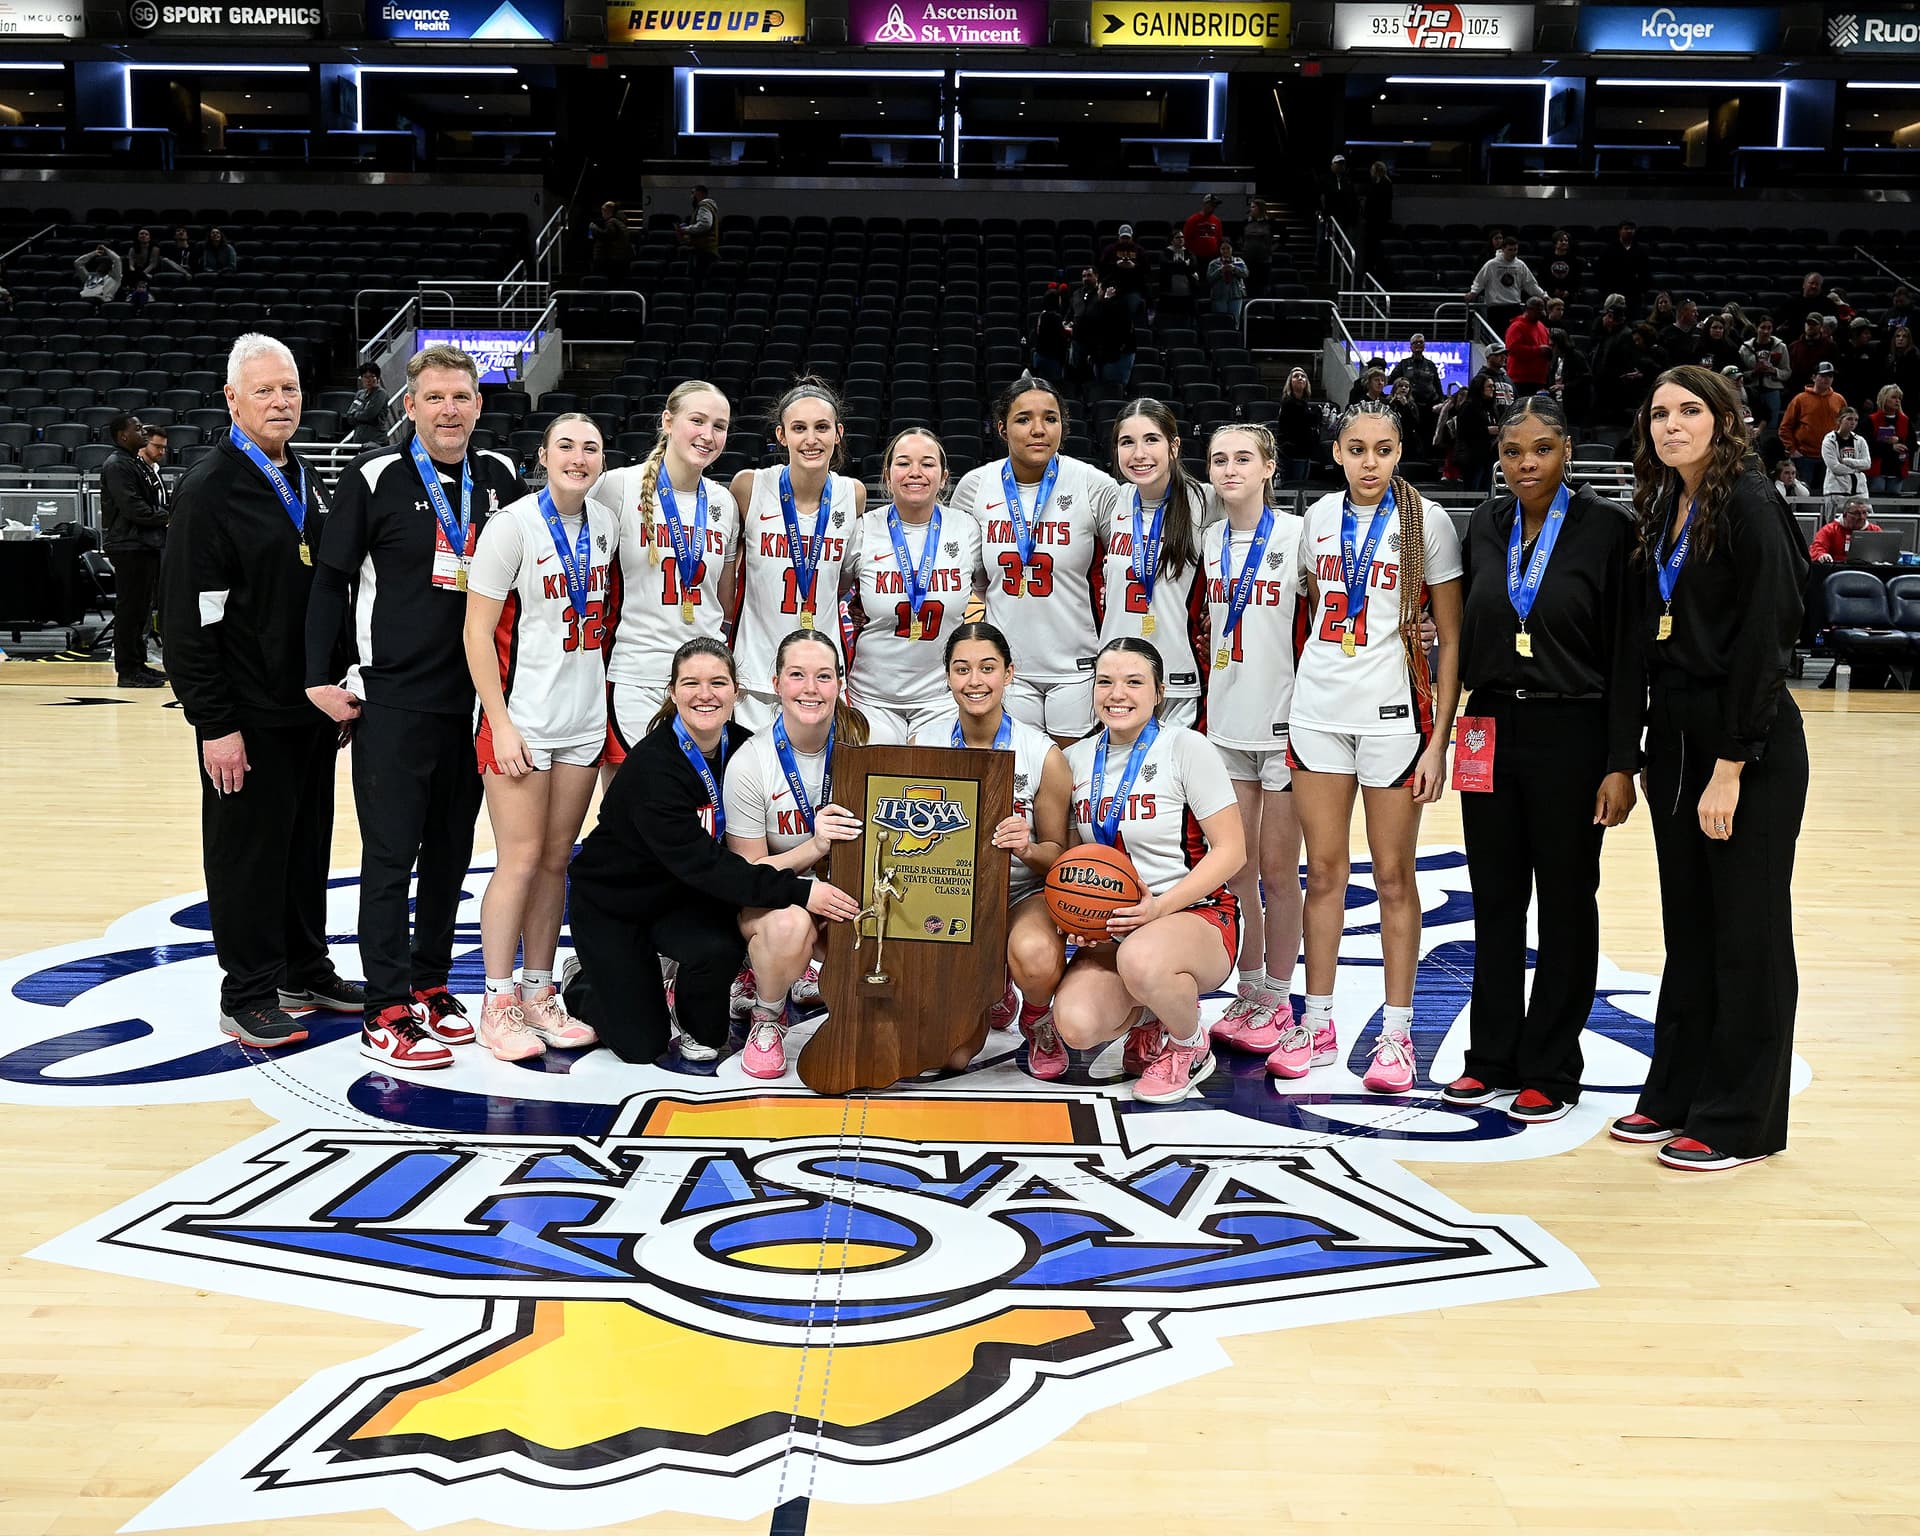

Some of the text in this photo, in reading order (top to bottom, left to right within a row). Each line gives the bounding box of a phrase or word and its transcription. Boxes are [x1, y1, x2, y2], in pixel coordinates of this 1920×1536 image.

[23, 14, 82, 22] IMCU.COM
[162, 6, 321, 25] SPORT GRAPHICS
[382, 6, 450, 20] Elevance
[414, 20, 450, 31] Health
[627, 10, 760, 31] REVVED UP
[922, 3, 1018, 20] Ascension
[1132, 12, 1280, 37] GAINBRIDGE
[1372, 18, 1400, 35] 93.5
[1402, 4, 1451, 28] the
[1467, 18, 1499, 35] 107.5
[1641, 8, 1715, 51] Kroger
[1864, 18, 1920, 42] Ruo
[920, 24, 1021, 42] St. Vincent
[1413, 26, 1465, 49] fan
[264, 463, 294, 505] BASKETBALL
[428, 482, 453, 527] BASKETBALL
[1011, 499, 1026, 541] BASKETBALL
[669, 516, 685, 562] BASKETBALL
[693, 526, 703, 561] CHAMPION
[788, 523, 803, 568] BASKETBALL
[809, 533, 822, 570] CHAMPION
[1145, 538, 1157, 576] CHAMPION
[562, 554, 579, 592] CHAMPION
[897, 545, 913, 587] BASKETBALL
[918, 555, 933, 589] CHAMPION
[997, 551, 1055, 598] 33
[1355, 537, 1377, 586] BASKETBALL
[1510, 545, 1520, 592] BASKETBALL
[1526, 549, 1548, 589] CHAMPION
[780, 566, 819, 616] 11
[1234, 567, 1255, 611] BASKETBALL
[562, 600, 603, 653] 32
[894, 599, 945, 642] 10
[1318, 590, 1370, 647] 21
[701, 768, 720, 814] BASKETBALL
[788, 771, 811, 818] BASKETBALL
[1110, 779, 1131, 819] CHAMPION
[875, 797, 968, 832] IHSAA
[895, 864, 972, 877] GIRLS BASKETBALL
[903, 874, 971, 886] STATE CHAMPION
[956, 859, 972, 868] 2024
[1059, 866, 1125, 894] Wilson
[934, 886, 971, 896] CLASS 2A
[180, 1137, 1485, 1302] IHSAA
